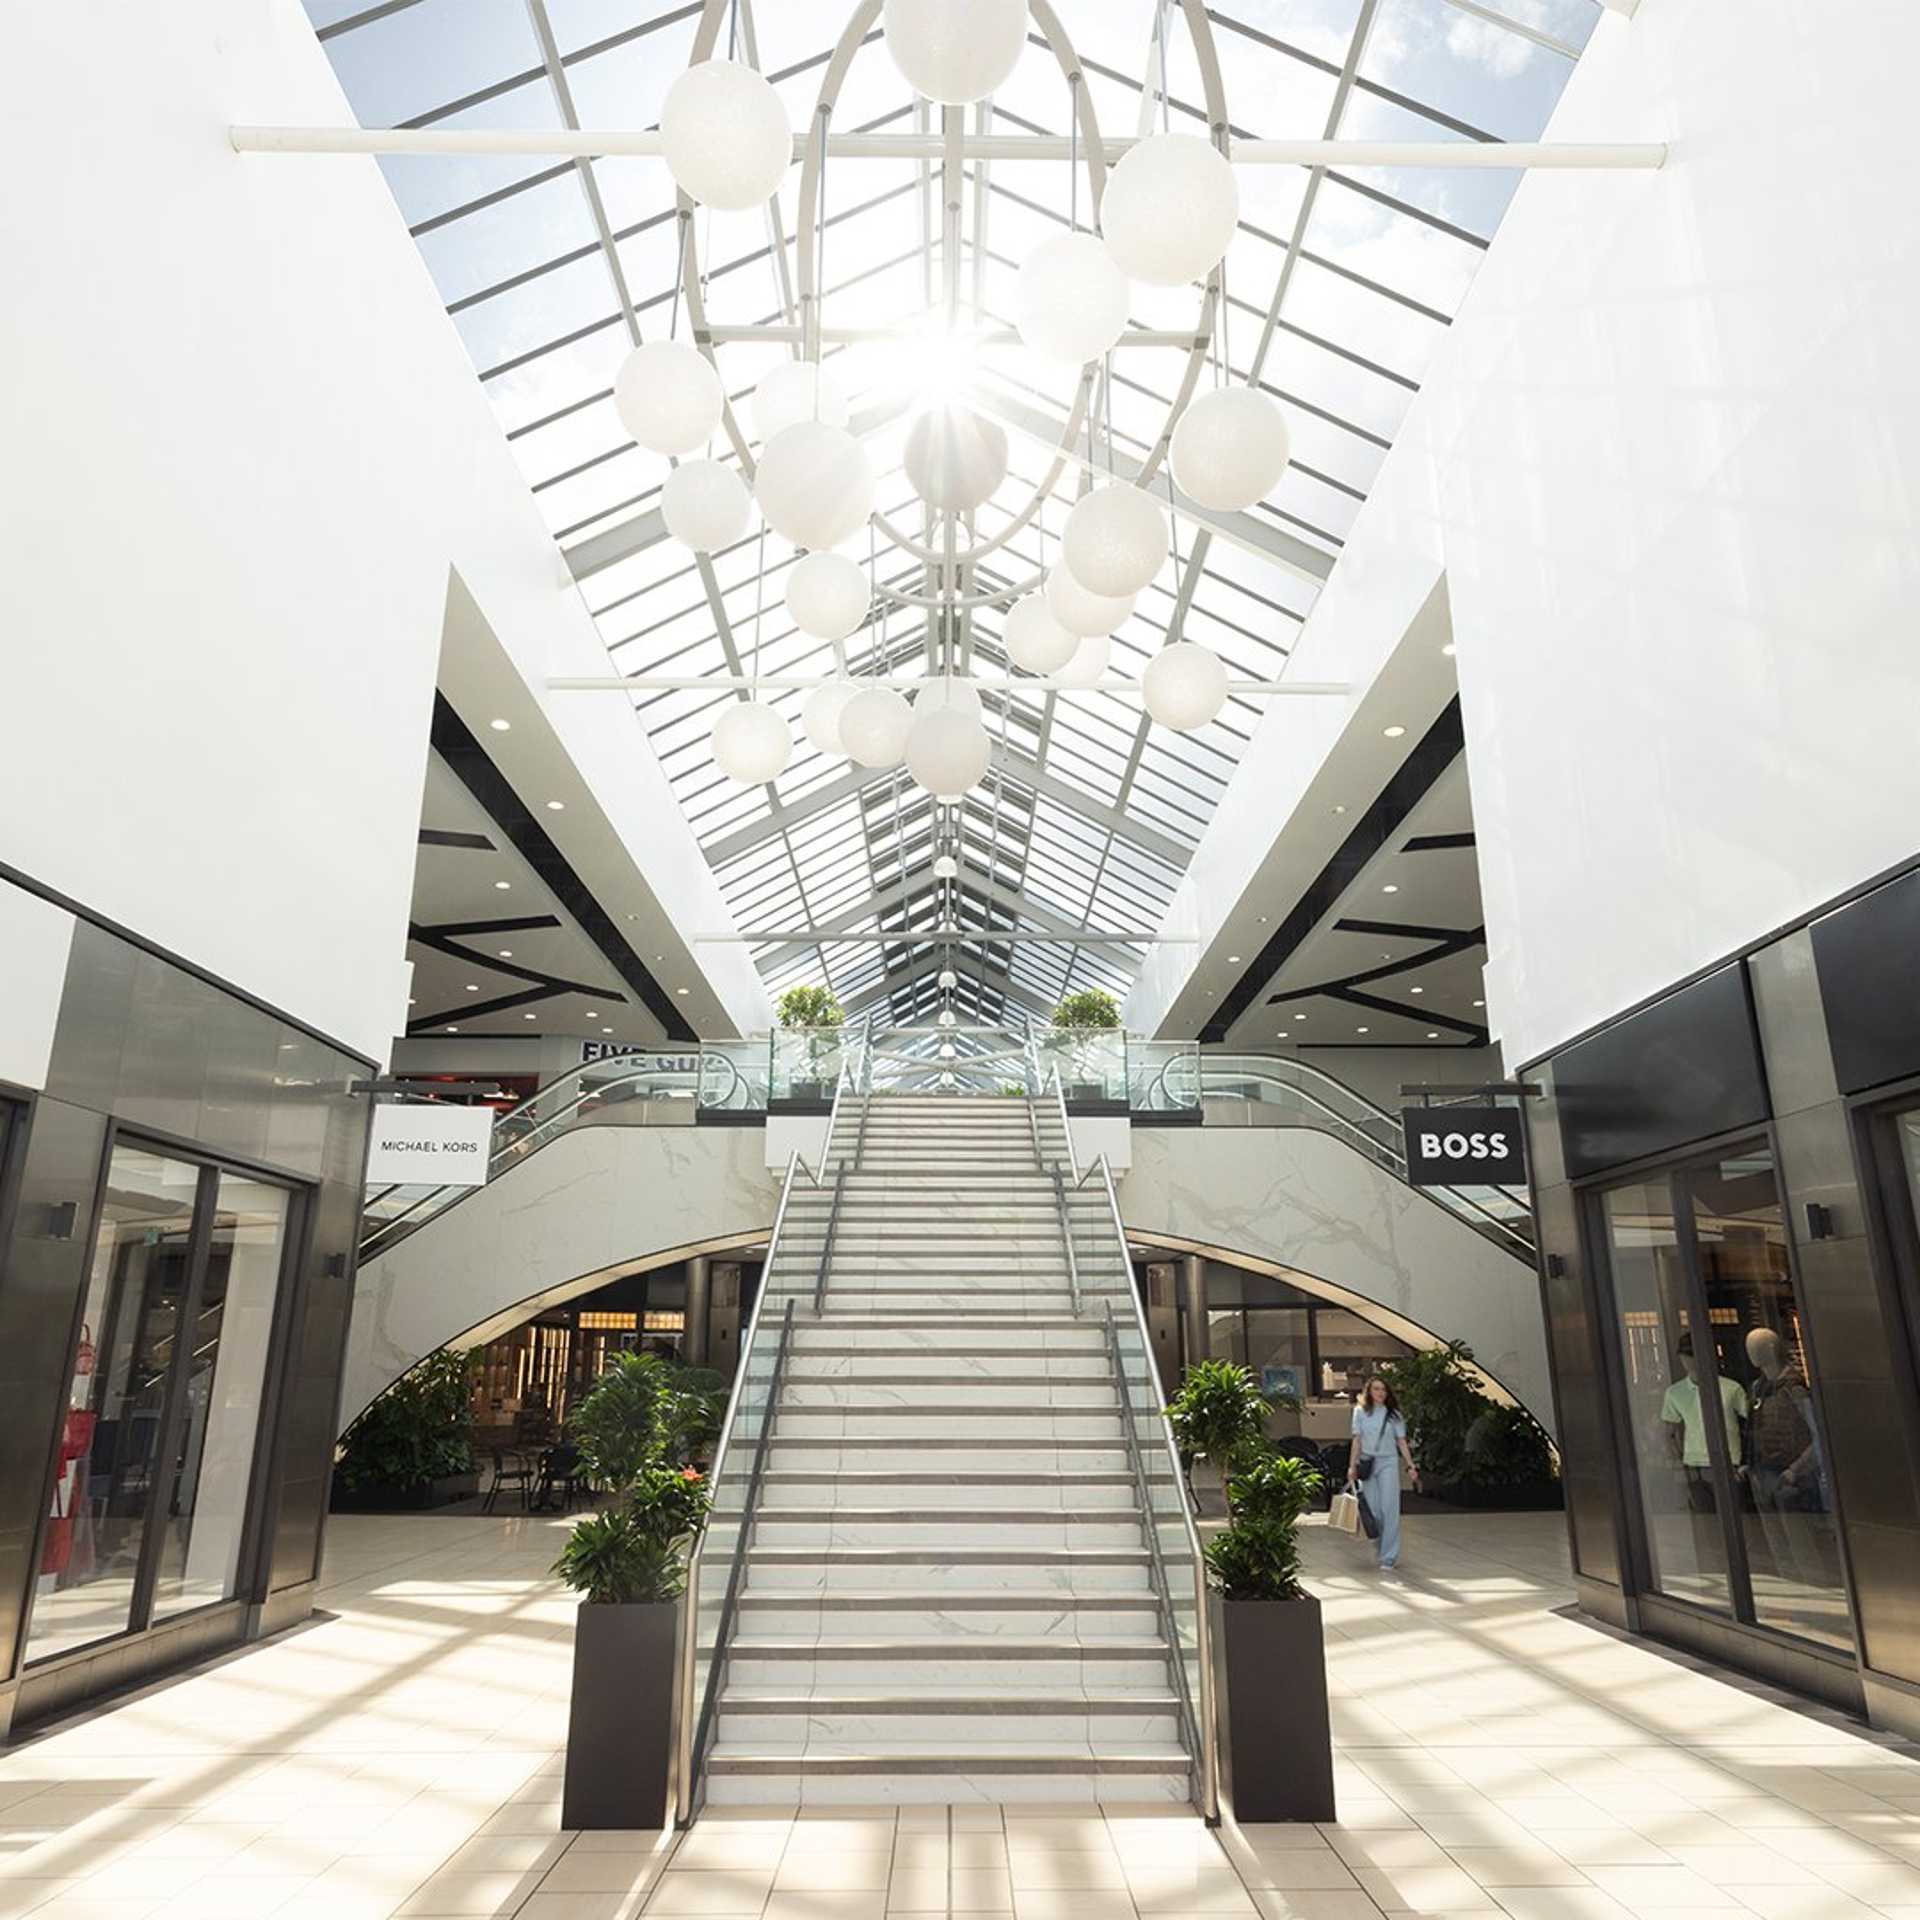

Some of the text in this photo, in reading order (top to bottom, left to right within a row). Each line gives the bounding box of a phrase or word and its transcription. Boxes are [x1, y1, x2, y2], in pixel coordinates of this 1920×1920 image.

[380, 1140, 478, 1153] MICHAEL KORS
[1420, 1132, 1509, 1159] BOSS
